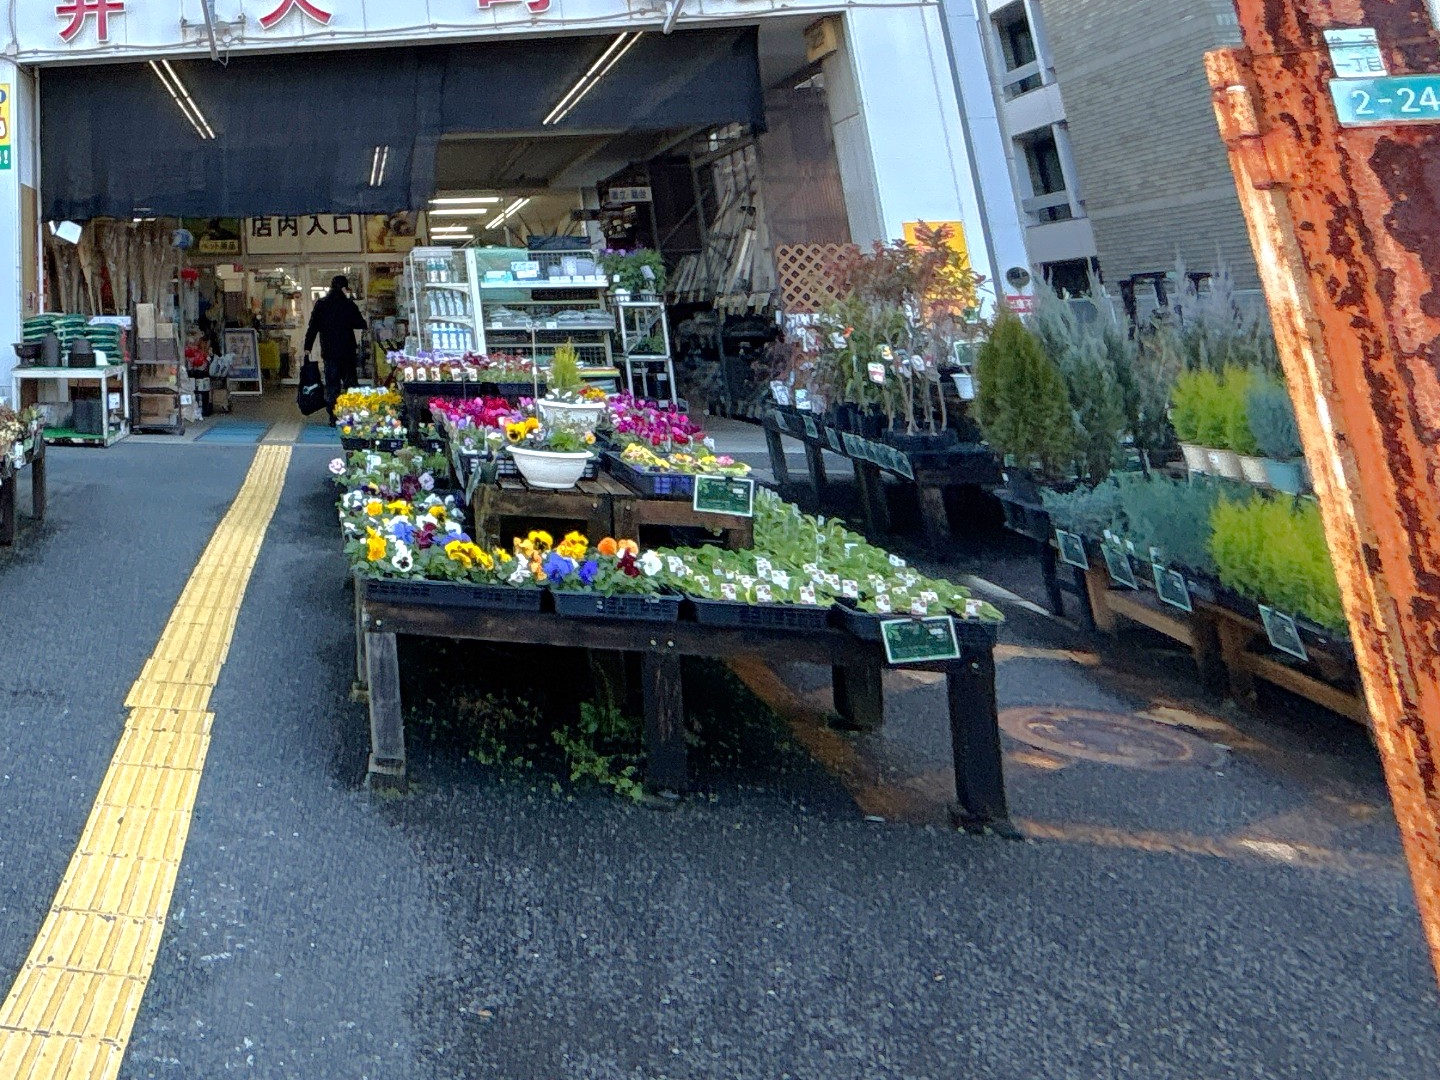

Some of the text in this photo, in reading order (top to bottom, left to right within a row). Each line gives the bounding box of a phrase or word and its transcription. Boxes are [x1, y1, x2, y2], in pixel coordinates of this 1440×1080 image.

[1351, 86, 1440, 115] 2-24
[251, 214, 353, 238] 店内入口
